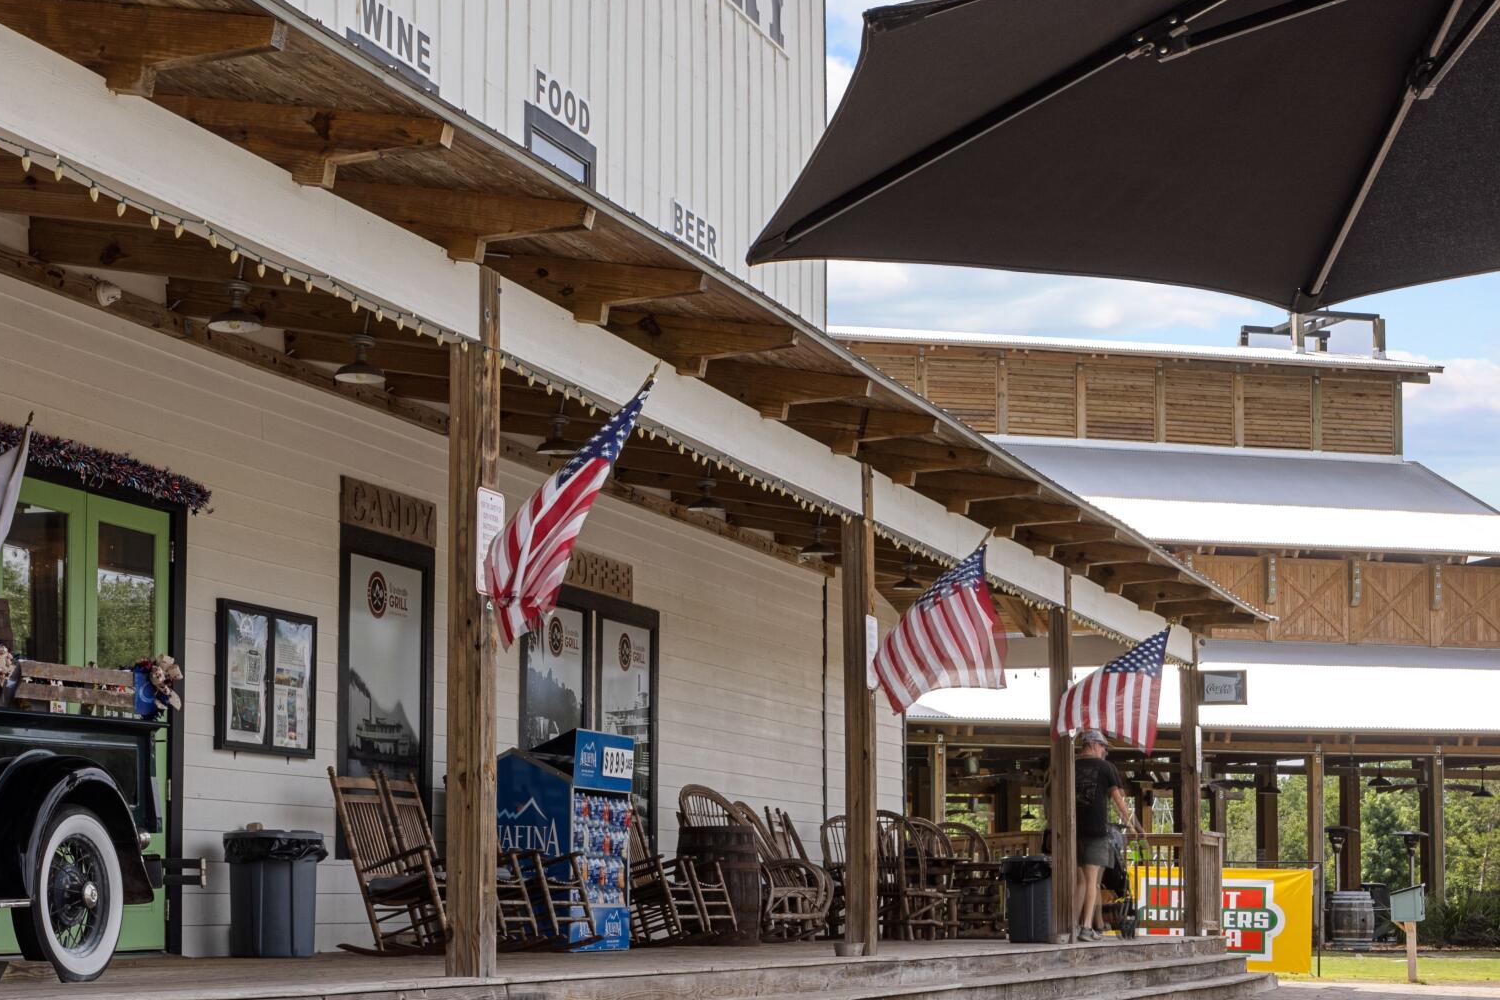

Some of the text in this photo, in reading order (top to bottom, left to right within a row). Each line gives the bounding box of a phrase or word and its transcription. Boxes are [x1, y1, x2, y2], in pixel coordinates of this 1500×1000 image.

[536, 69, 590, 135] FOOD
[674, 201, 717, 258] BEER
[353, 485, 433, 540] CANDY
[388, 595, 409, 611] GRILL
